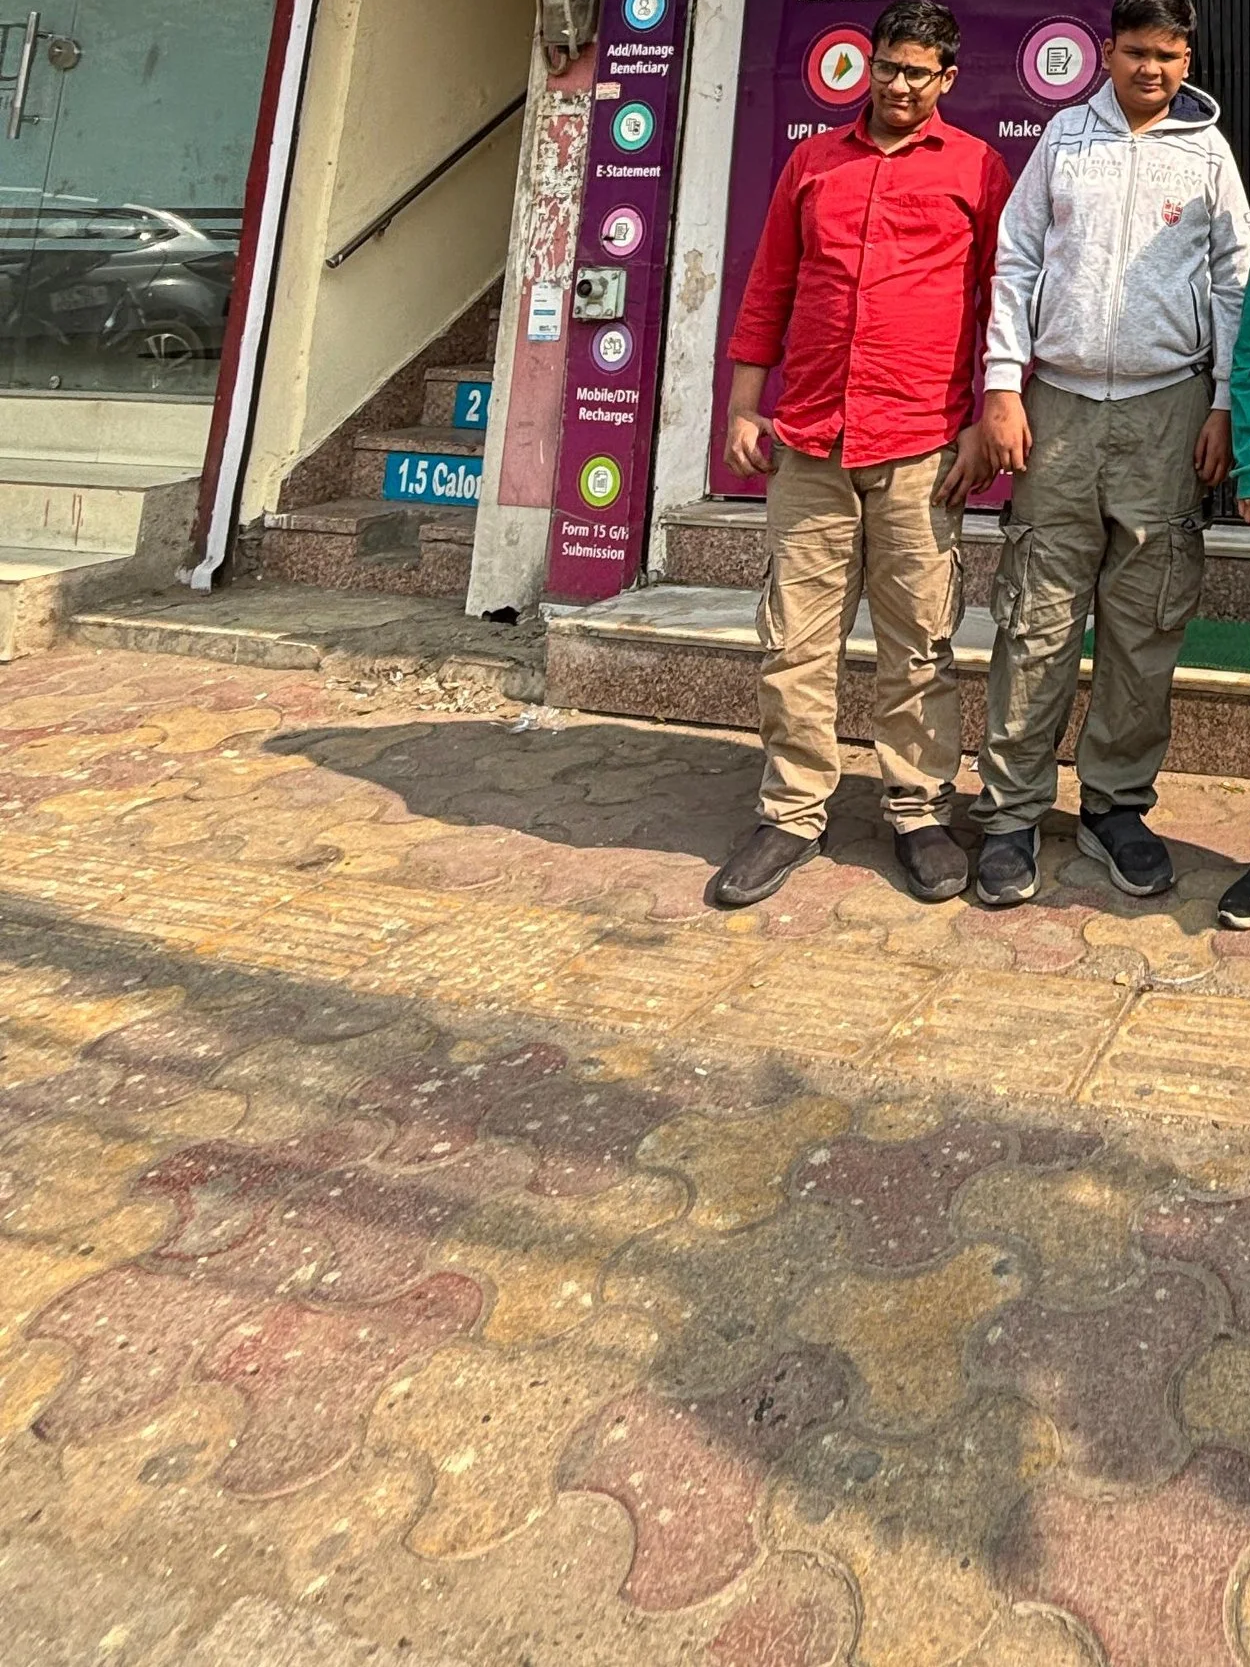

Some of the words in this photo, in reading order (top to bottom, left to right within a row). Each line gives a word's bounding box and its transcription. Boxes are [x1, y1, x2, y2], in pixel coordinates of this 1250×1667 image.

[607, 43, 675, 59] Add/Manage
[610, 61, 669, 77] Beneficiary
[787, 123, 812, 140] UPI
[999, 119, 1042, 138] Make
[596, 164, 661, 178] E-Statement
[576, 387, 640, 404] Mobile/DTH
[465, 390, 482, 422] 2
[579, 407, 634, 426] Recharges
[398, 458, 429, 495] 1.5
[562, 521, 589, 537] Form
[593, 524, 606, 539] 15
[562, 542, 625, 561] Submission
